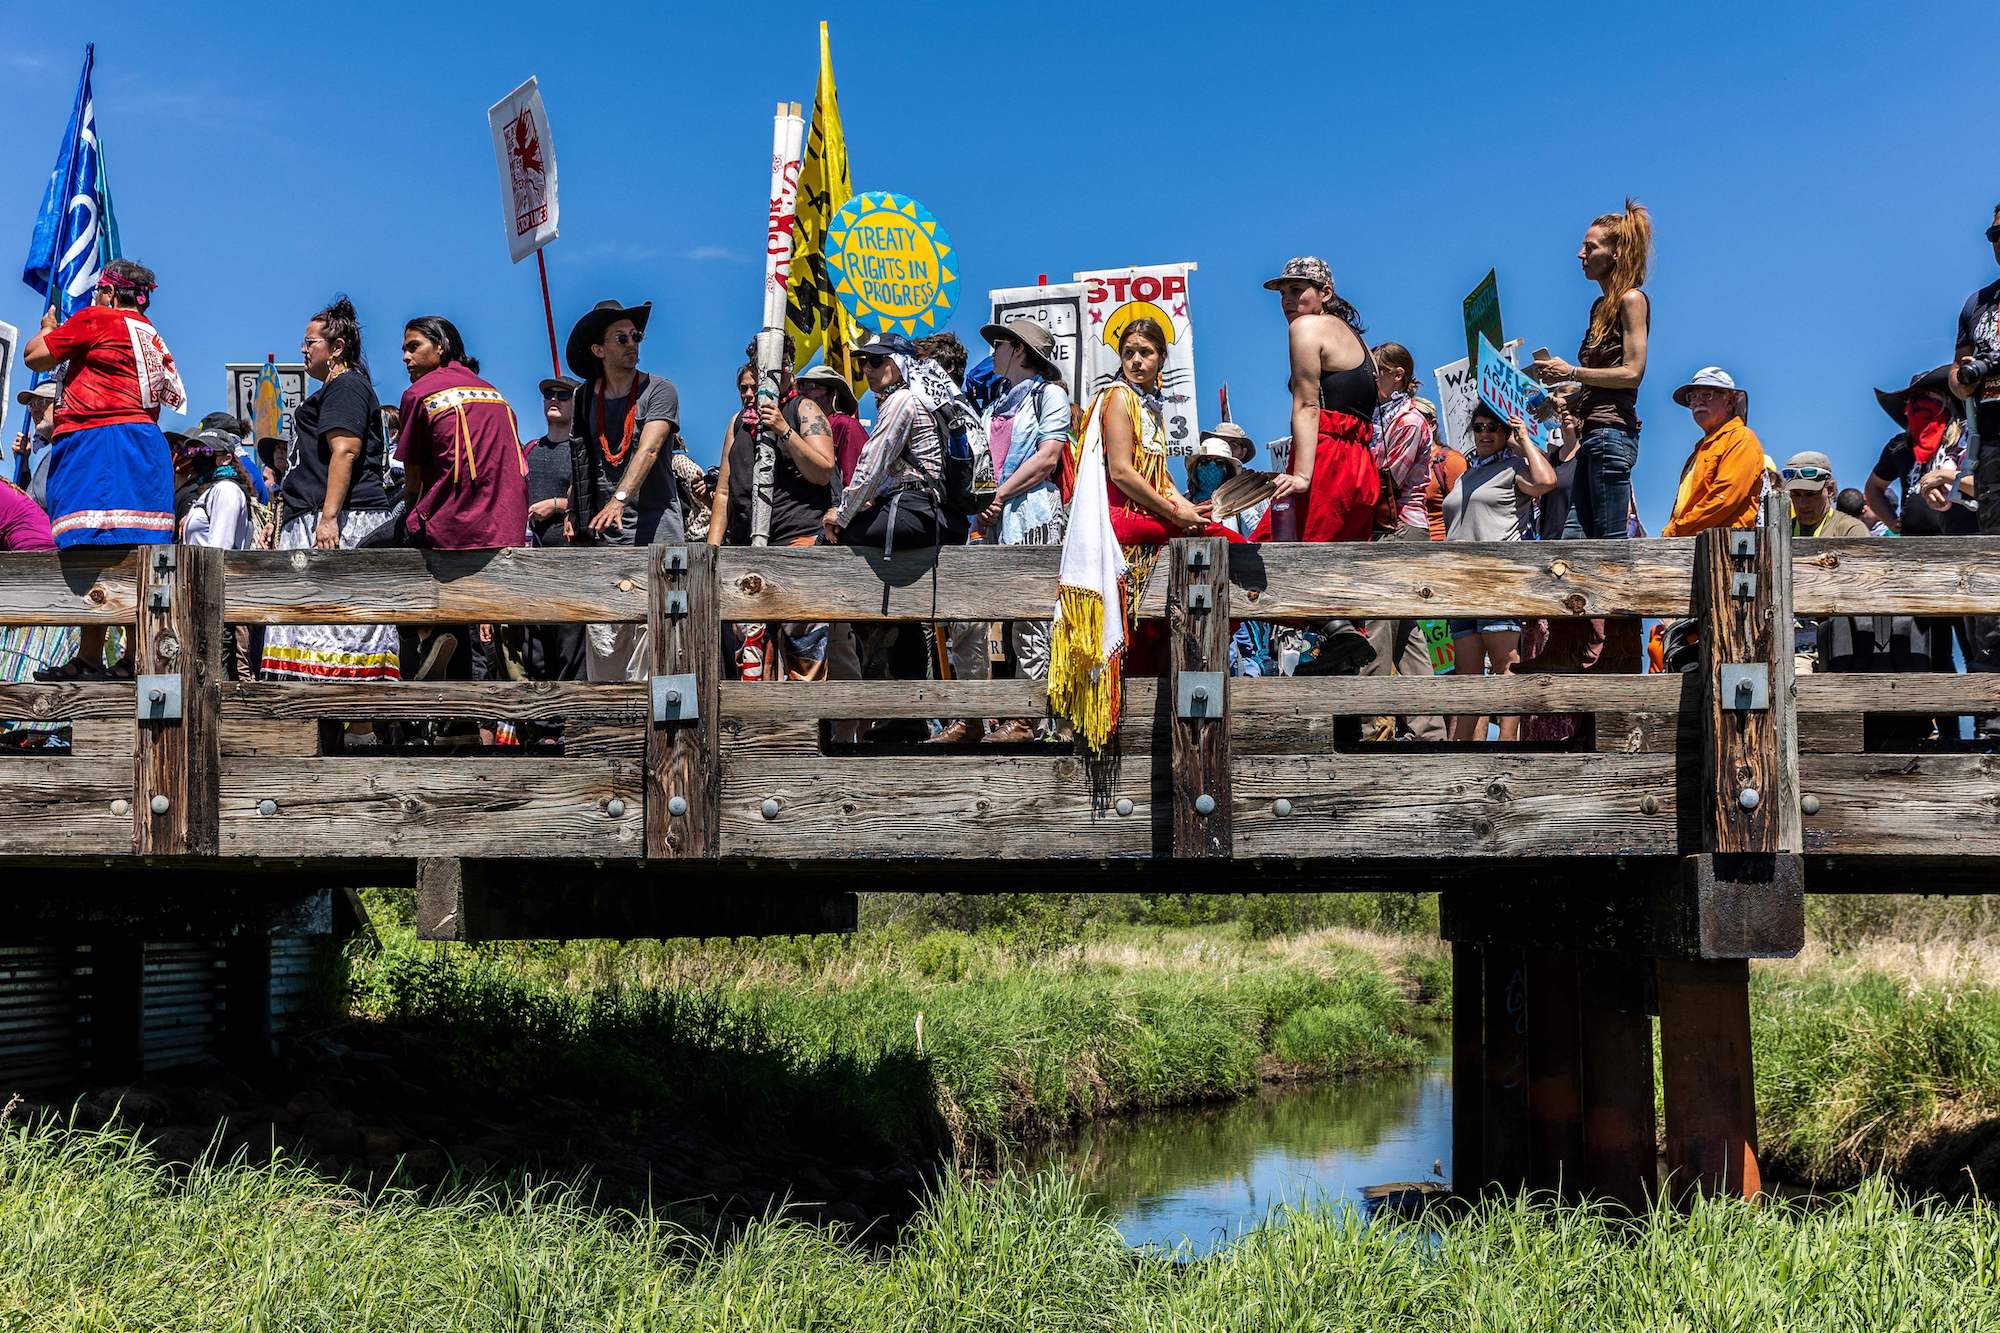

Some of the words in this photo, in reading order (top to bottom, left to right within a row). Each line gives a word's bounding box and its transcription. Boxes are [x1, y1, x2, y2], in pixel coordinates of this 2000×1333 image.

[853, 226, 916, 252] TREATY
[847, 252, 905, 280] RIGHTS
[908, 260, 928, 279] IN
[863, 281, 934, 307] PROGRESS
[1084, 276, 1186, 303] STOP
[1048, 345, 1069, 361] NE
[282, 398, 296, 408] NE
[1170, 415, 1189, 440] 3
